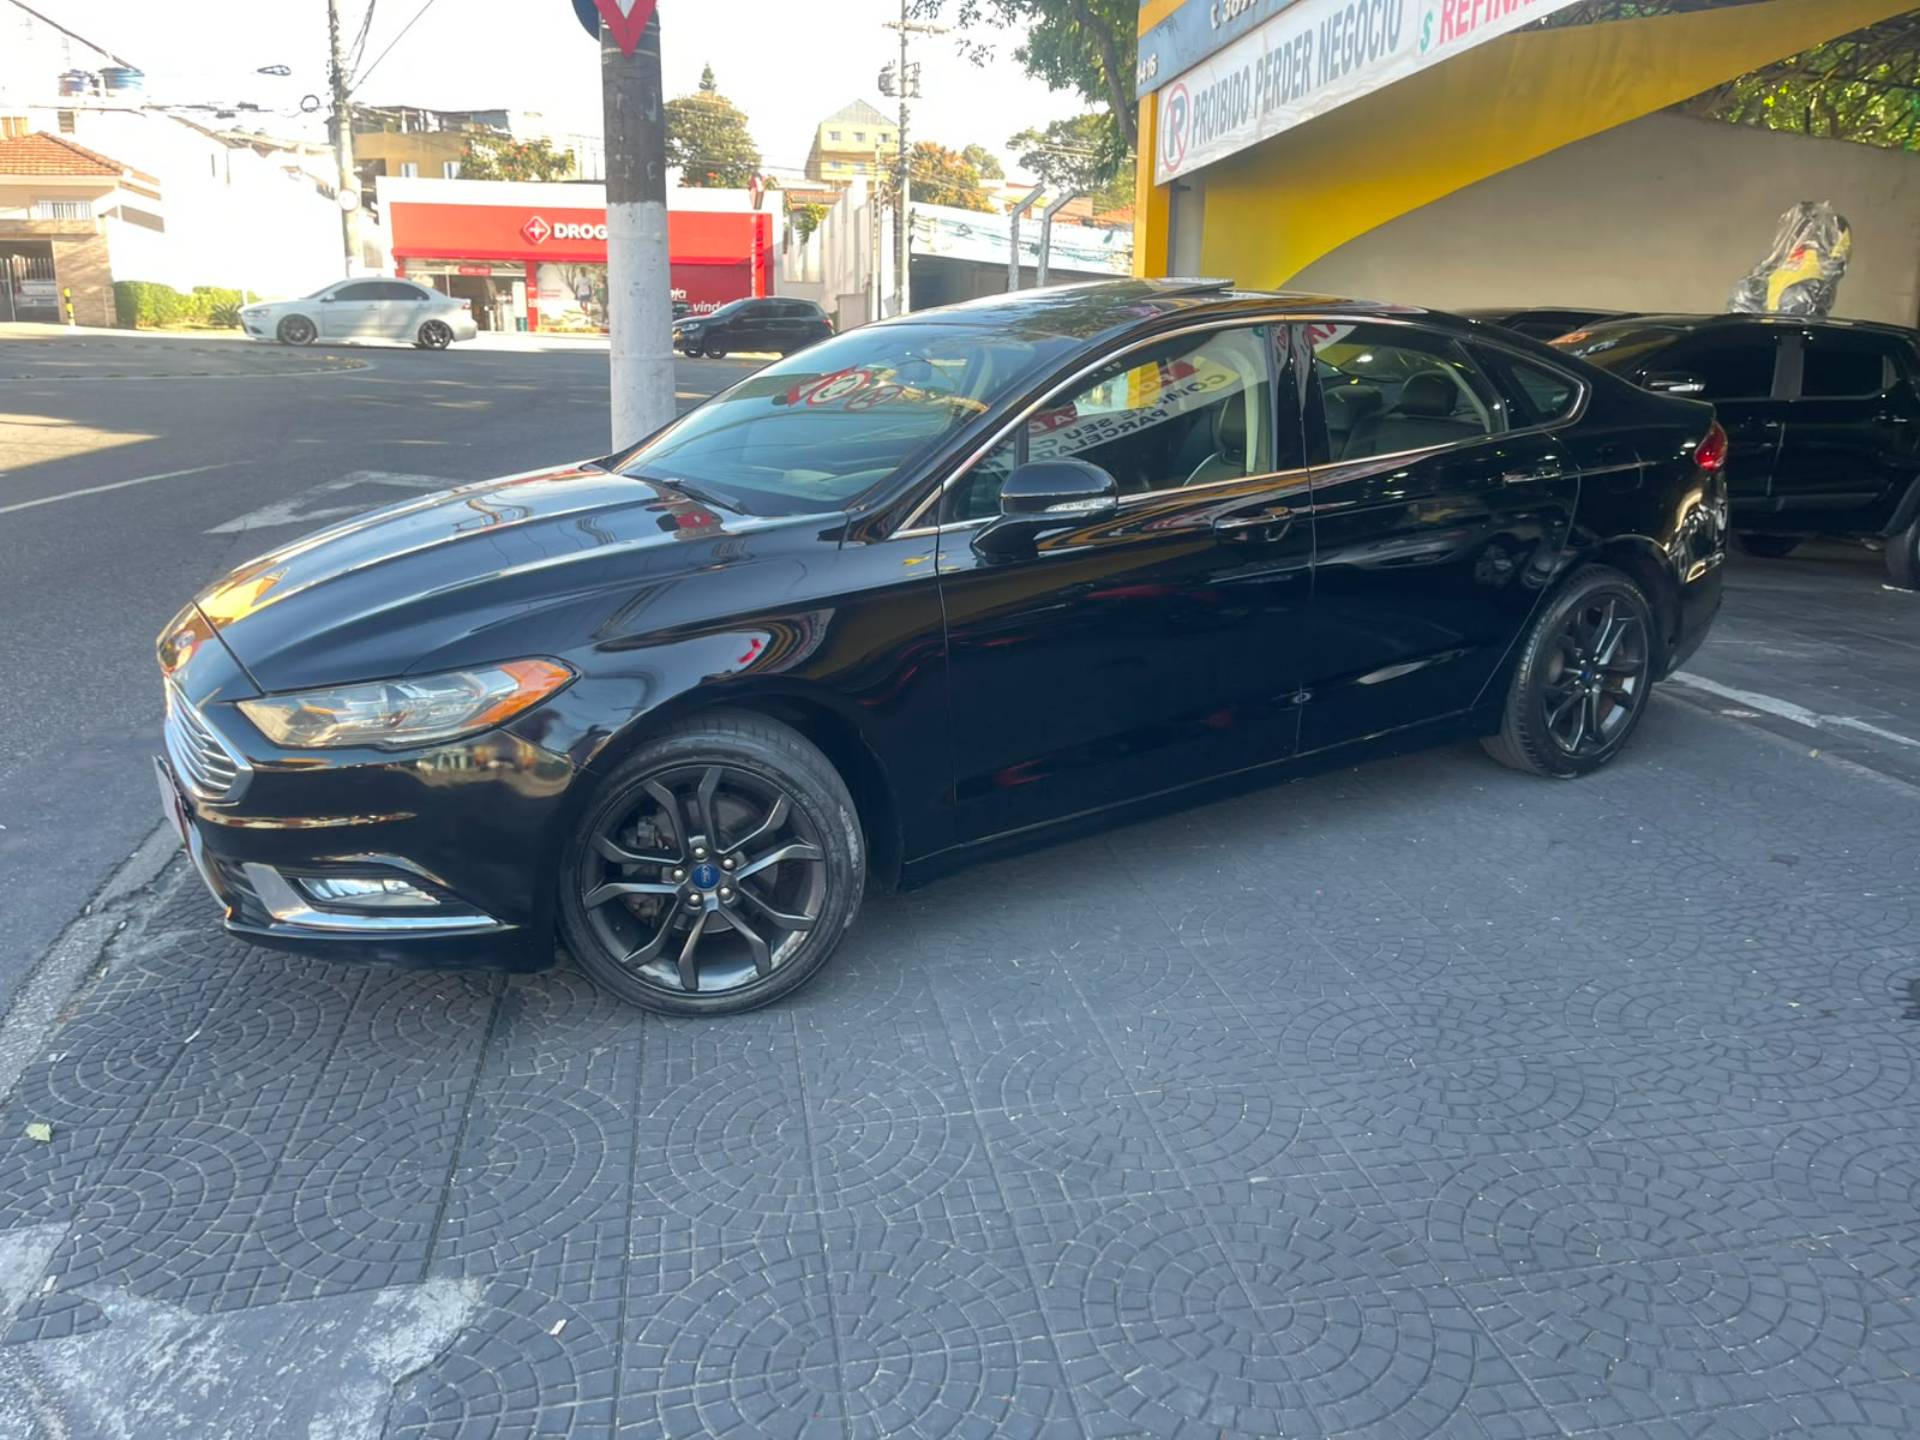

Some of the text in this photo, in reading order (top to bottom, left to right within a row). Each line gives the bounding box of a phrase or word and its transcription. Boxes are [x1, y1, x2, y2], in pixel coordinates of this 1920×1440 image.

[1192, 65, 1250, 148] PROIBIDO
[1254, 29, 1313, 119] PERDER
[553, 222, 607, 240] DROG
